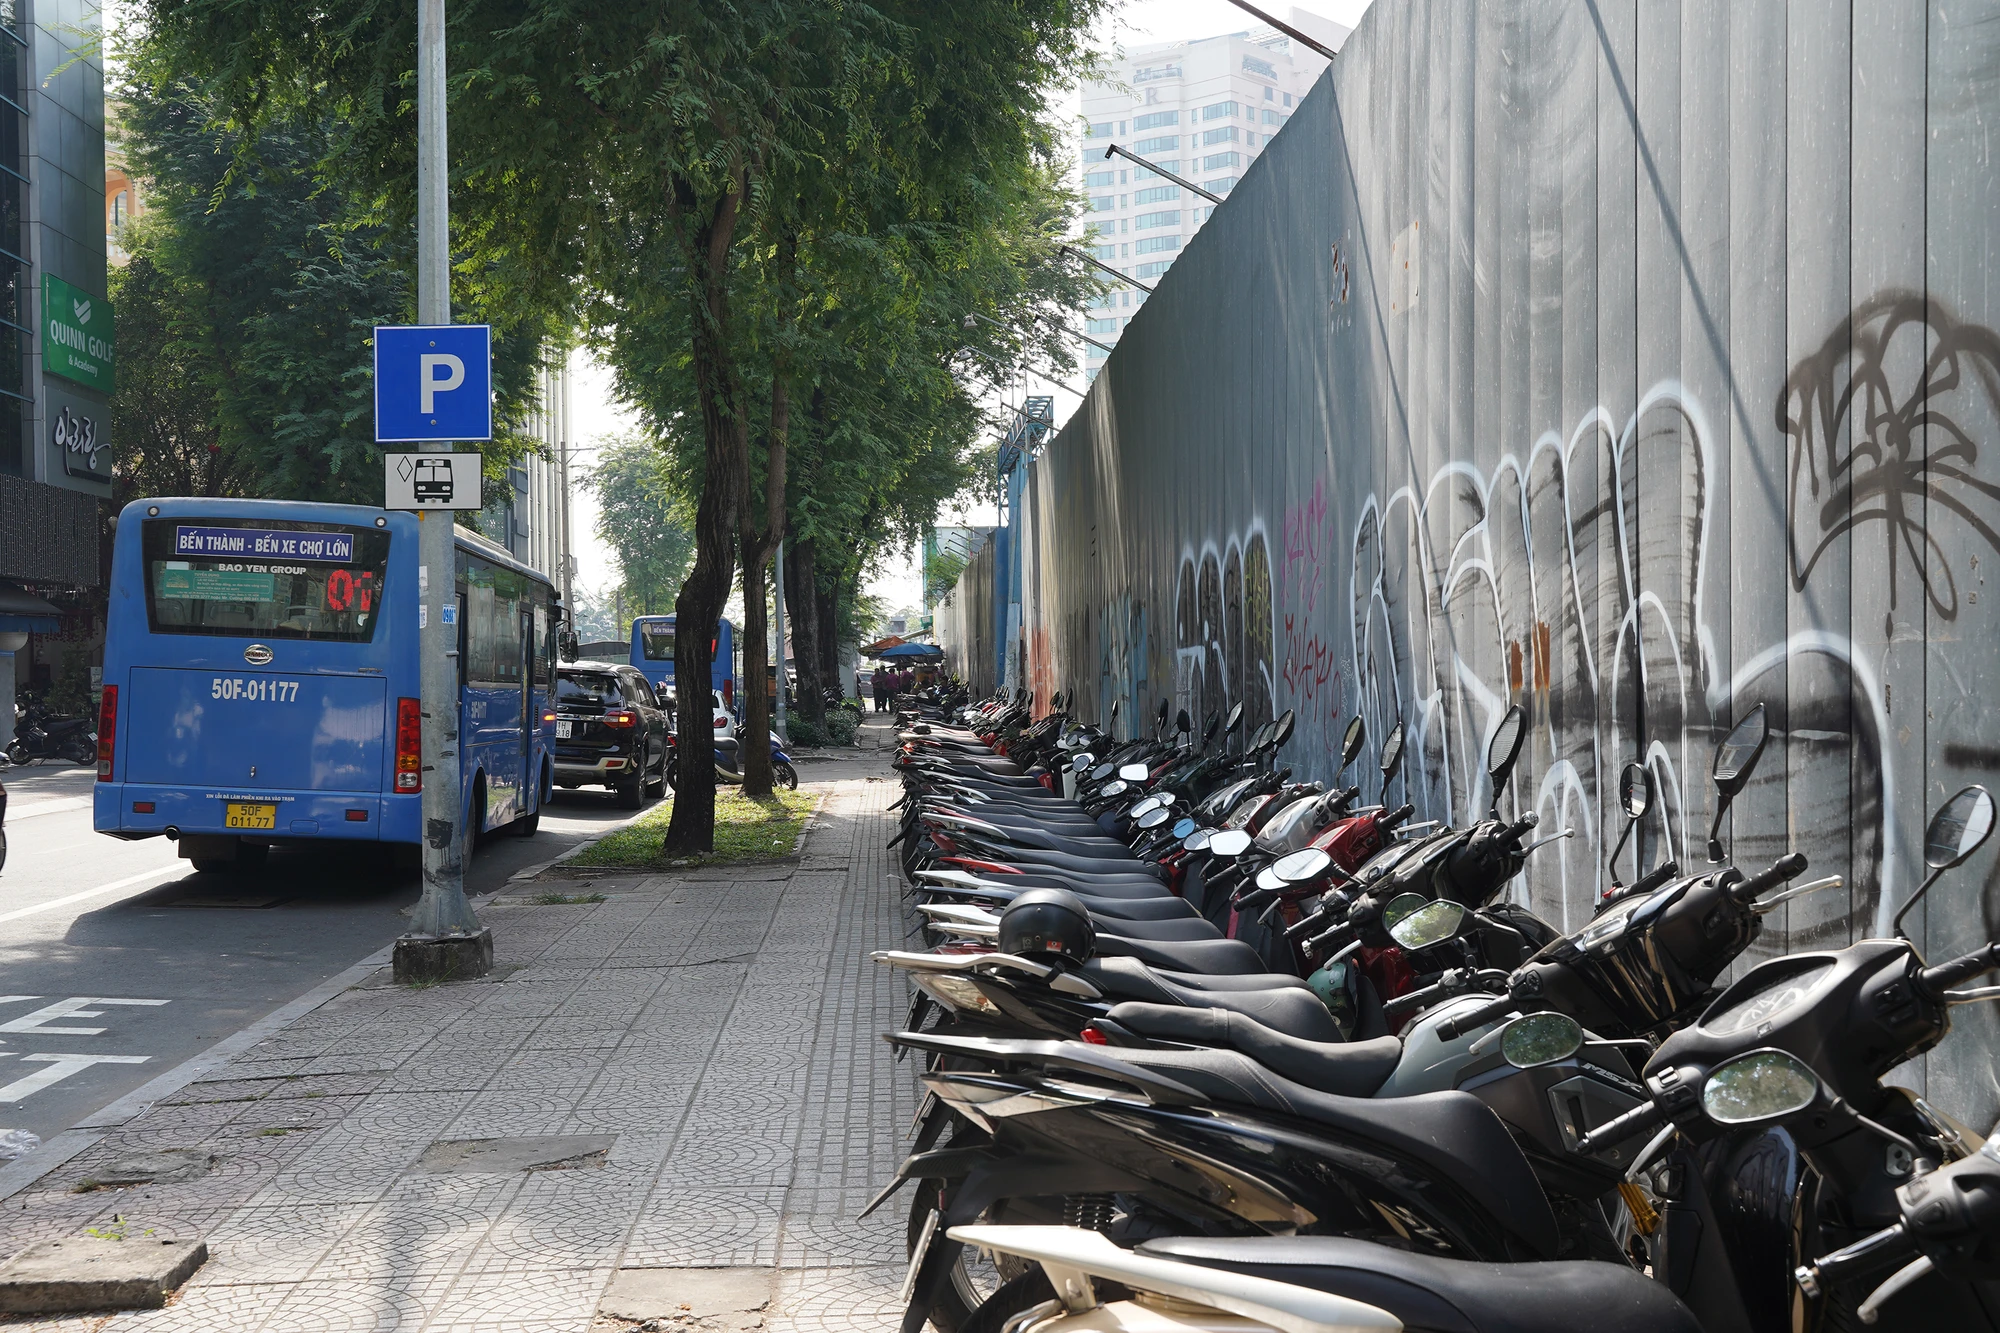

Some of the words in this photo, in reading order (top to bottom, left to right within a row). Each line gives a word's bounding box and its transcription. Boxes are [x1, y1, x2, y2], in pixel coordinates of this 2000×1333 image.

[50, 319, 85, 353] QUINN
[88, 336, 113, 363] GOLF
[69, 354, 74, 366] &
[74, 357, 98, 378] Academy
[420, 353, 465, 414] P
[180, 530, 203, 550] BẾN
[206, 533, 244, 551] THÀNH
[254, 533, 279, 553] BẾN
[281, 539, 297, 554] XE
[299, 539, 324, 558] CHỢ
[325, 538, 349, 557] LỚN
[218, 563, 243, 572] BAO
[246, 564, 268, 573] YEN
[270, 565, 307, 575] GROUP
[665, 674, 675, 682] 50F
[212, 678, 299, 702] 50F-01177
[556, 730, 571, 738] 9.18
[240, 806, 262, 816] 50F
[231, 816, 270, 827] 011.77
